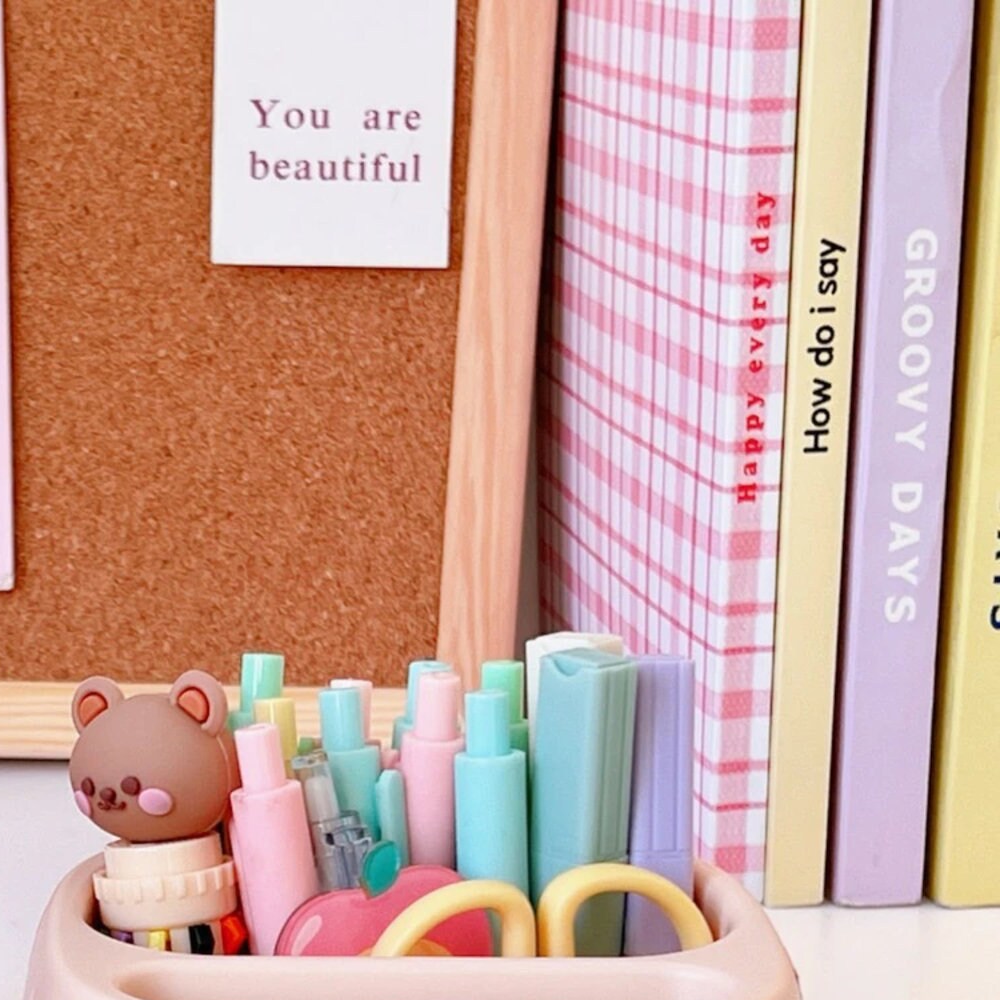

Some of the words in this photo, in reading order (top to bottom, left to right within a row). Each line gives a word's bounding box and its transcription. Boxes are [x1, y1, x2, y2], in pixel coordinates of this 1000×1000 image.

[249, 99, 331, 129] You
[362, 108, 421, 131] are
[248, 150, 421, 182] beautiful
[750, 192, 776, 254] day
[816, 238, 847, 296] say
[748, 274, 772, 374] every
[809, 306, 837, 314] i
[893, 227, 939, 452] GROOVY
[806, 324, 835, 367] do
[803, 378, 833, 454] How
[736, 392, 764, 504] Happy
[883, 481, 924, 624] DAYS
